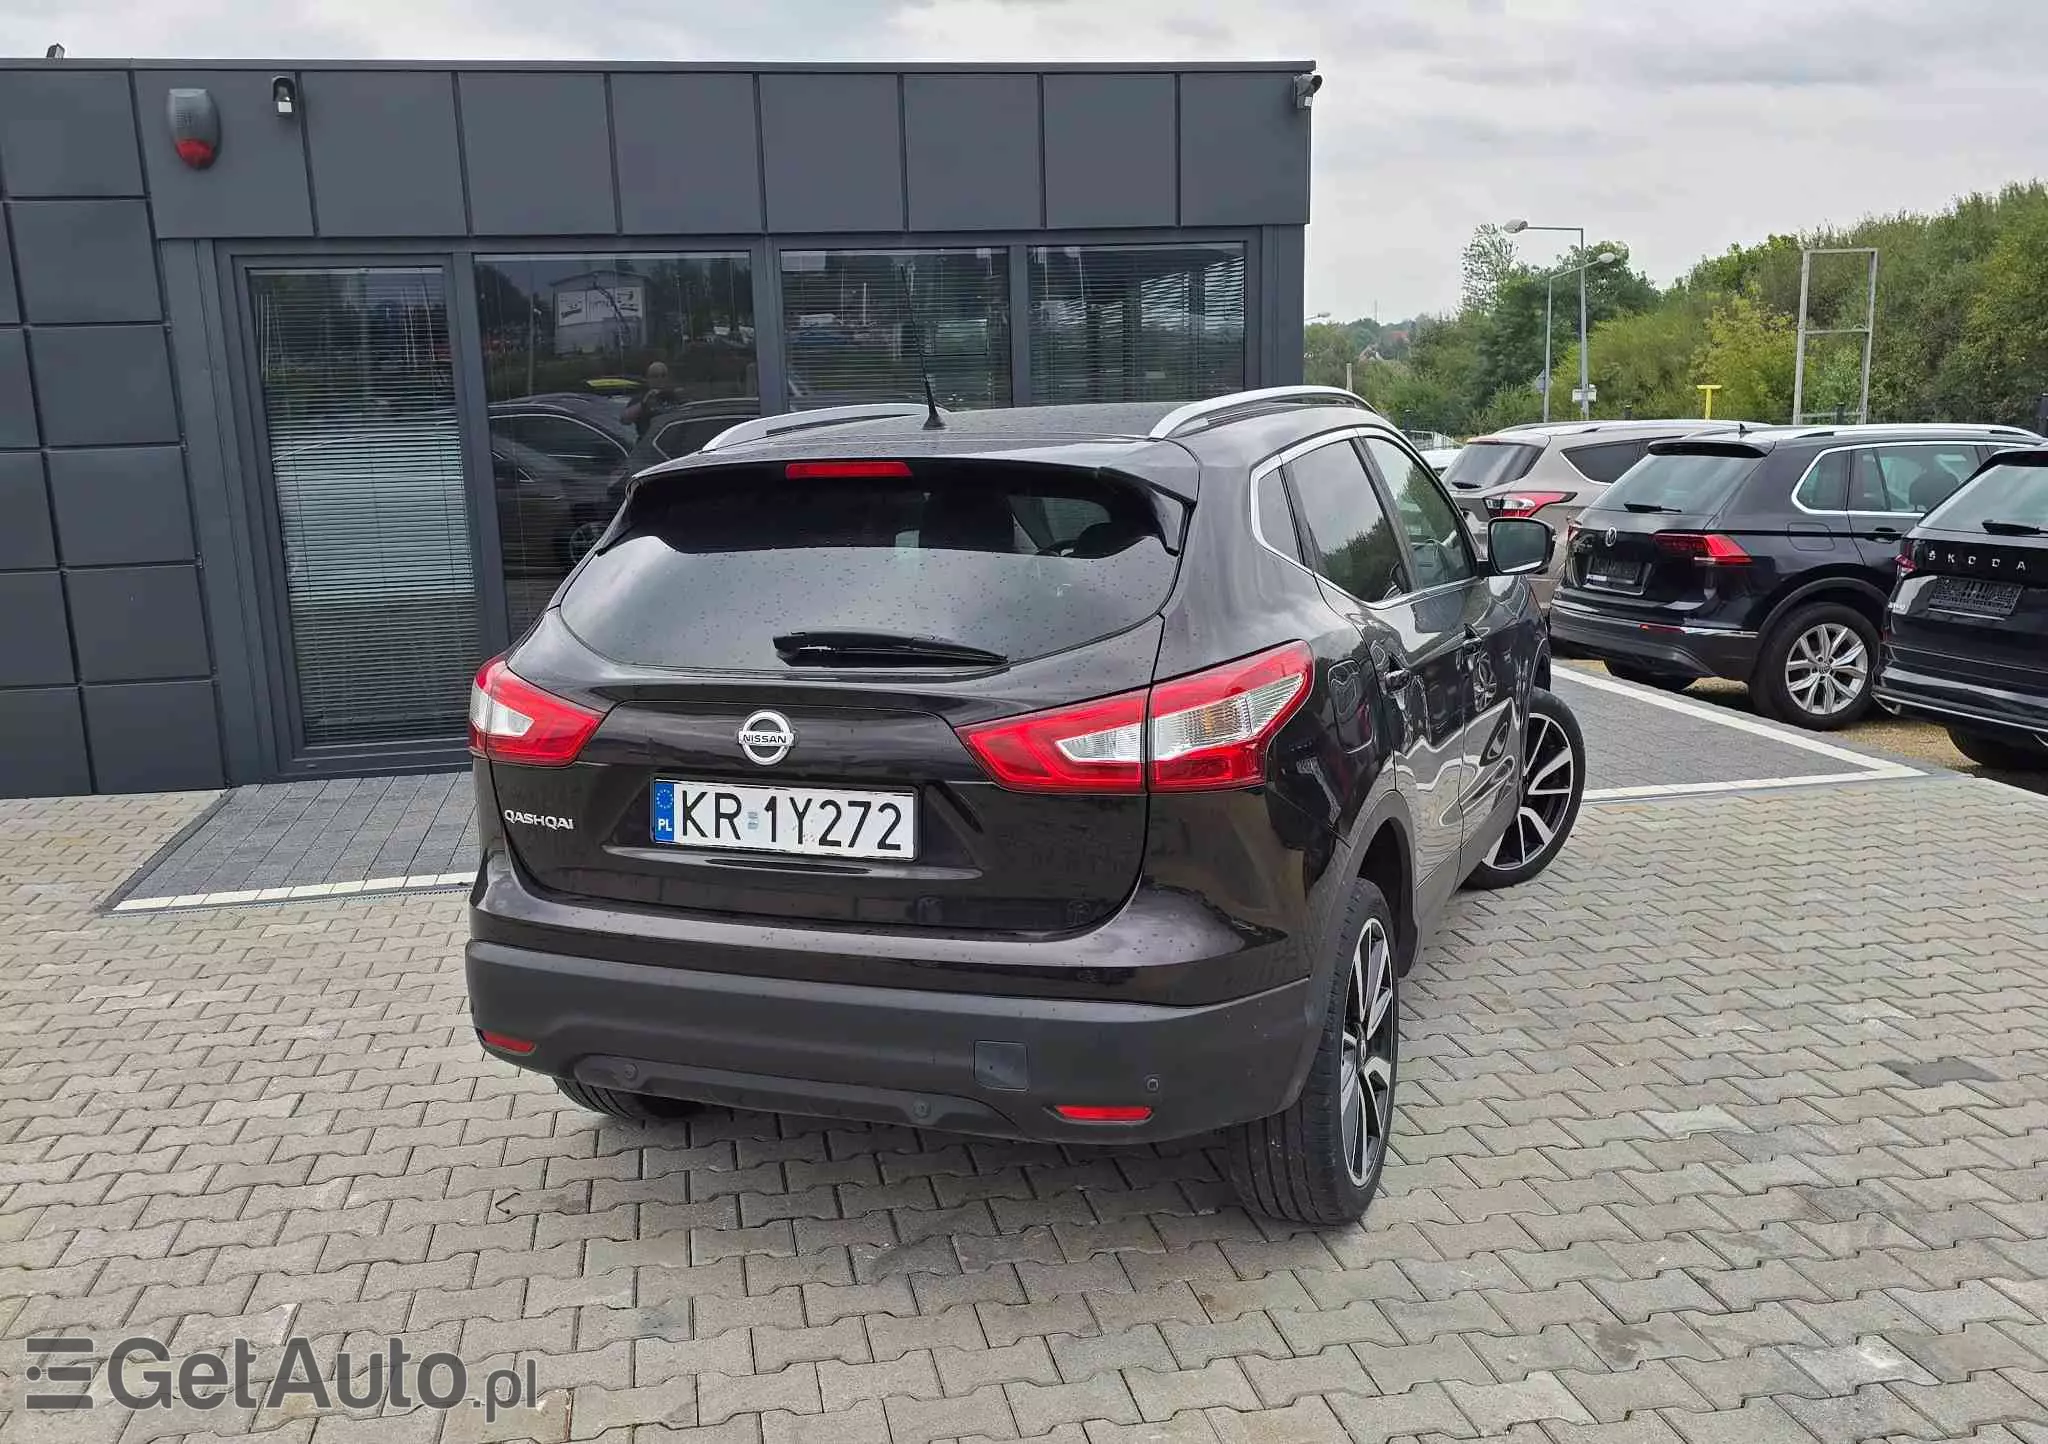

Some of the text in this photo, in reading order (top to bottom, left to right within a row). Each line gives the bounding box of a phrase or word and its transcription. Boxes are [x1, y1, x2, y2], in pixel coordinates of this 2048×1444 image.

[743, 734, 787, 744] NISSAN
[504, 809, 574, 830] QASHQAI
[658, 818, 673, 832] PL
[682, 790, 902, 851] KR 1Y272
